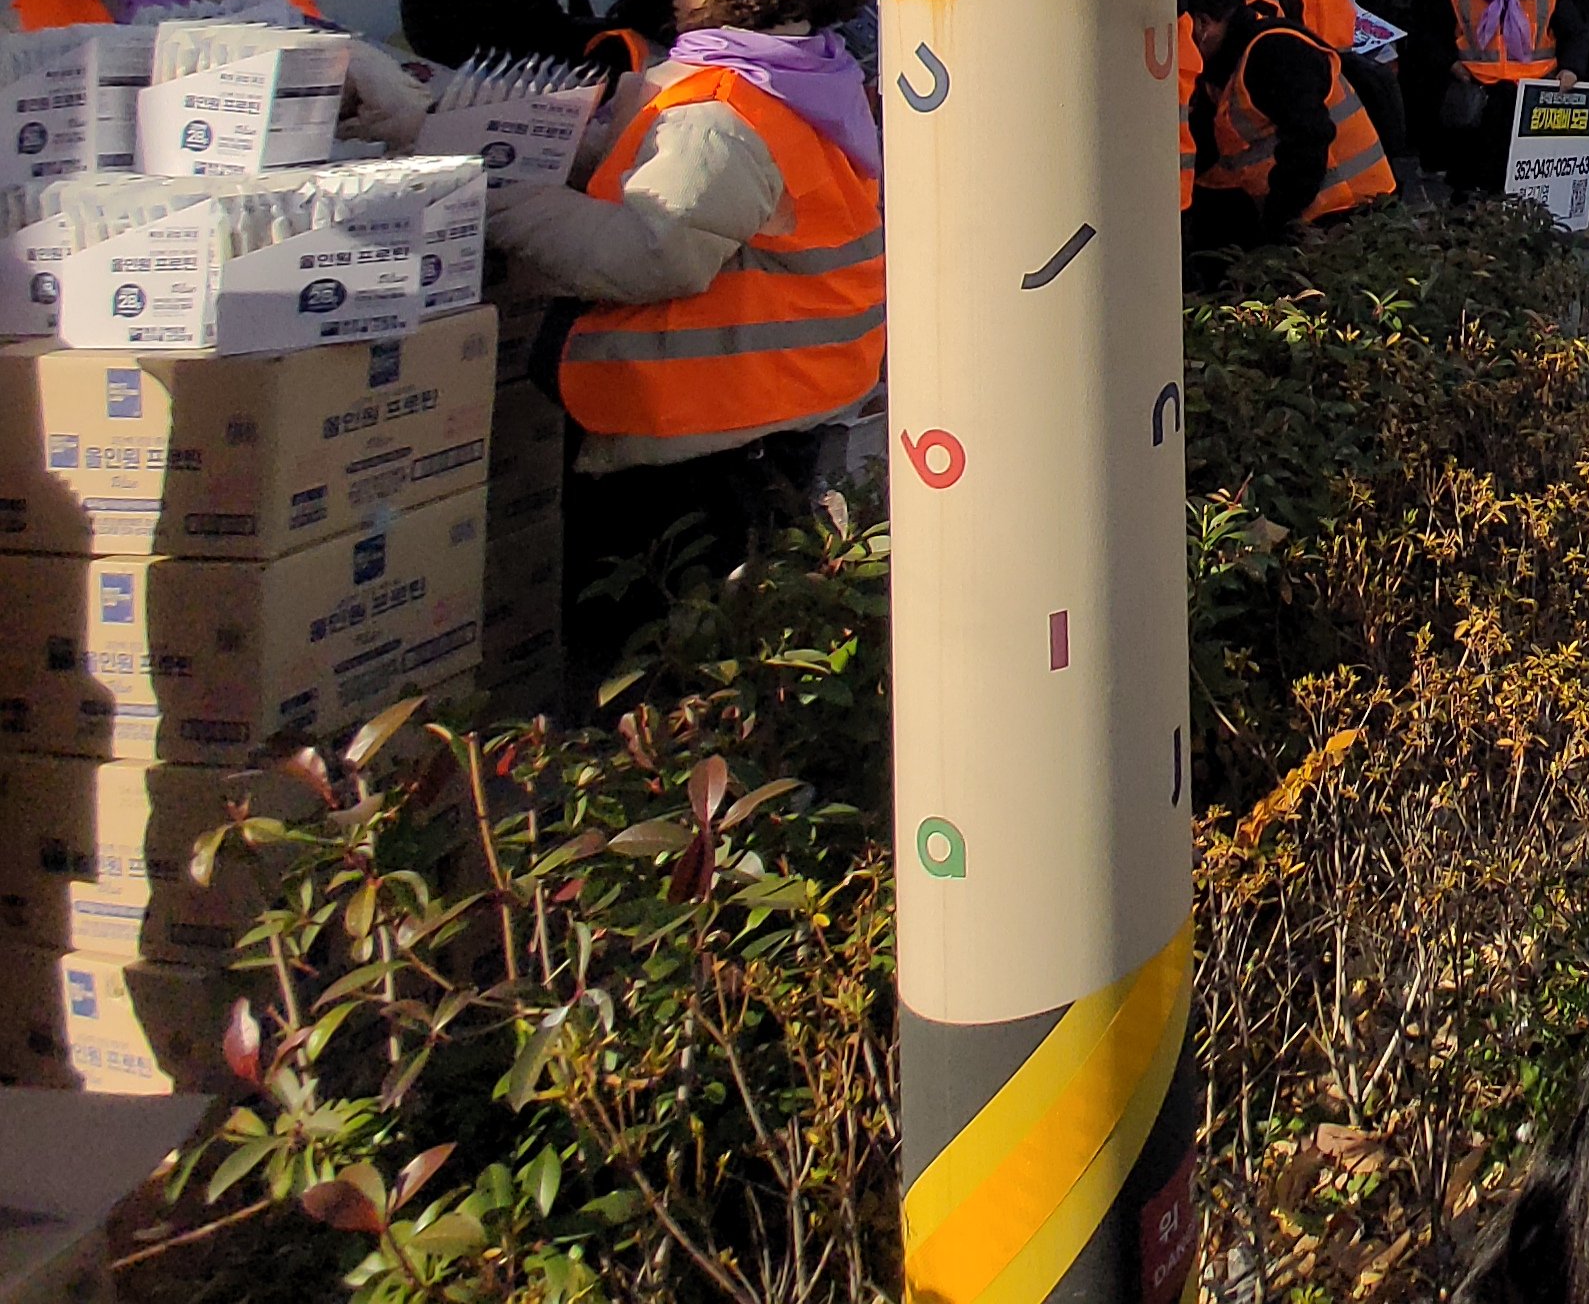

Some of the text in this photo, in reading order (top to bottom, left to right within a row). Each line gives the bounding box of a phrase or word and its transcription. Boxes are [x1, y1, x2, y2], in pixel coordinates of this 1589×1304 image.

[299, 245, 411, 270] 올인원 프로틴
[321, 387, 440, 440] 올인원 프로틴
[85, 446, 141, 470] 올인원
[309, 576, 426, 643] 올인원 프로틴
